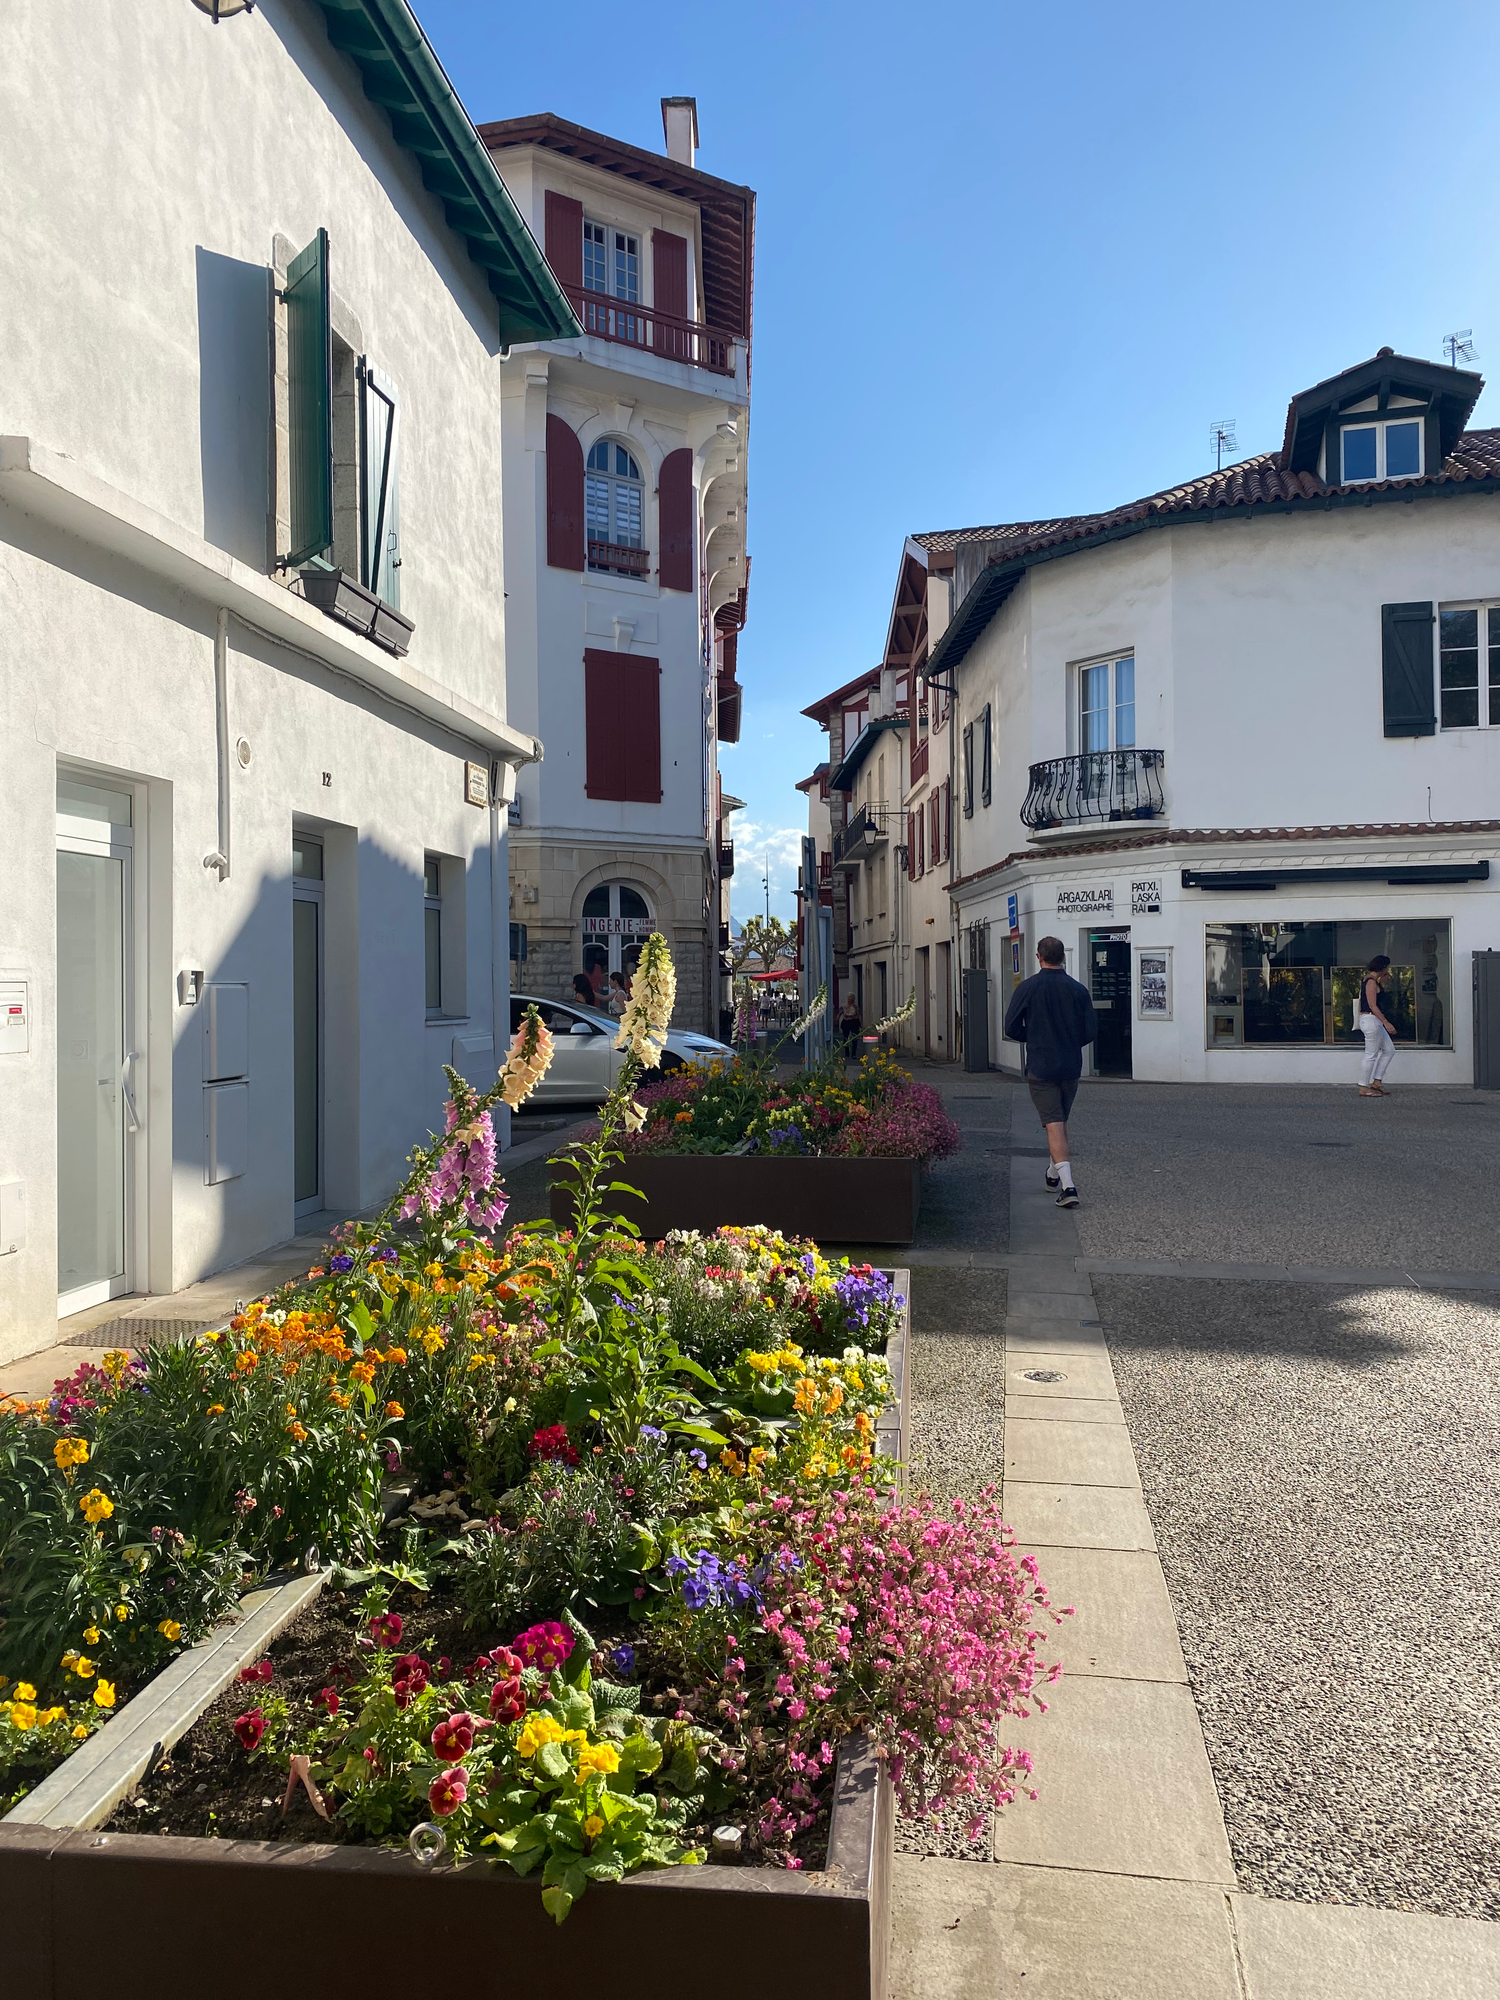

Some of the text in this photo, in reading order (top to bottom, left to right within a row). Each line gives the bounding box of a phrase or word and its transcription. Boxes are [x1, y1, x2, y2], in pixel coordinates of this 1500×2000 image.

[322, 771, 332, 788] 12
[1132, 892, 1160, 903] LASKA
[1058, 903, 1113, 914] PHOTOGRAPHE
[1132, 904, 1146, 914] RAI
